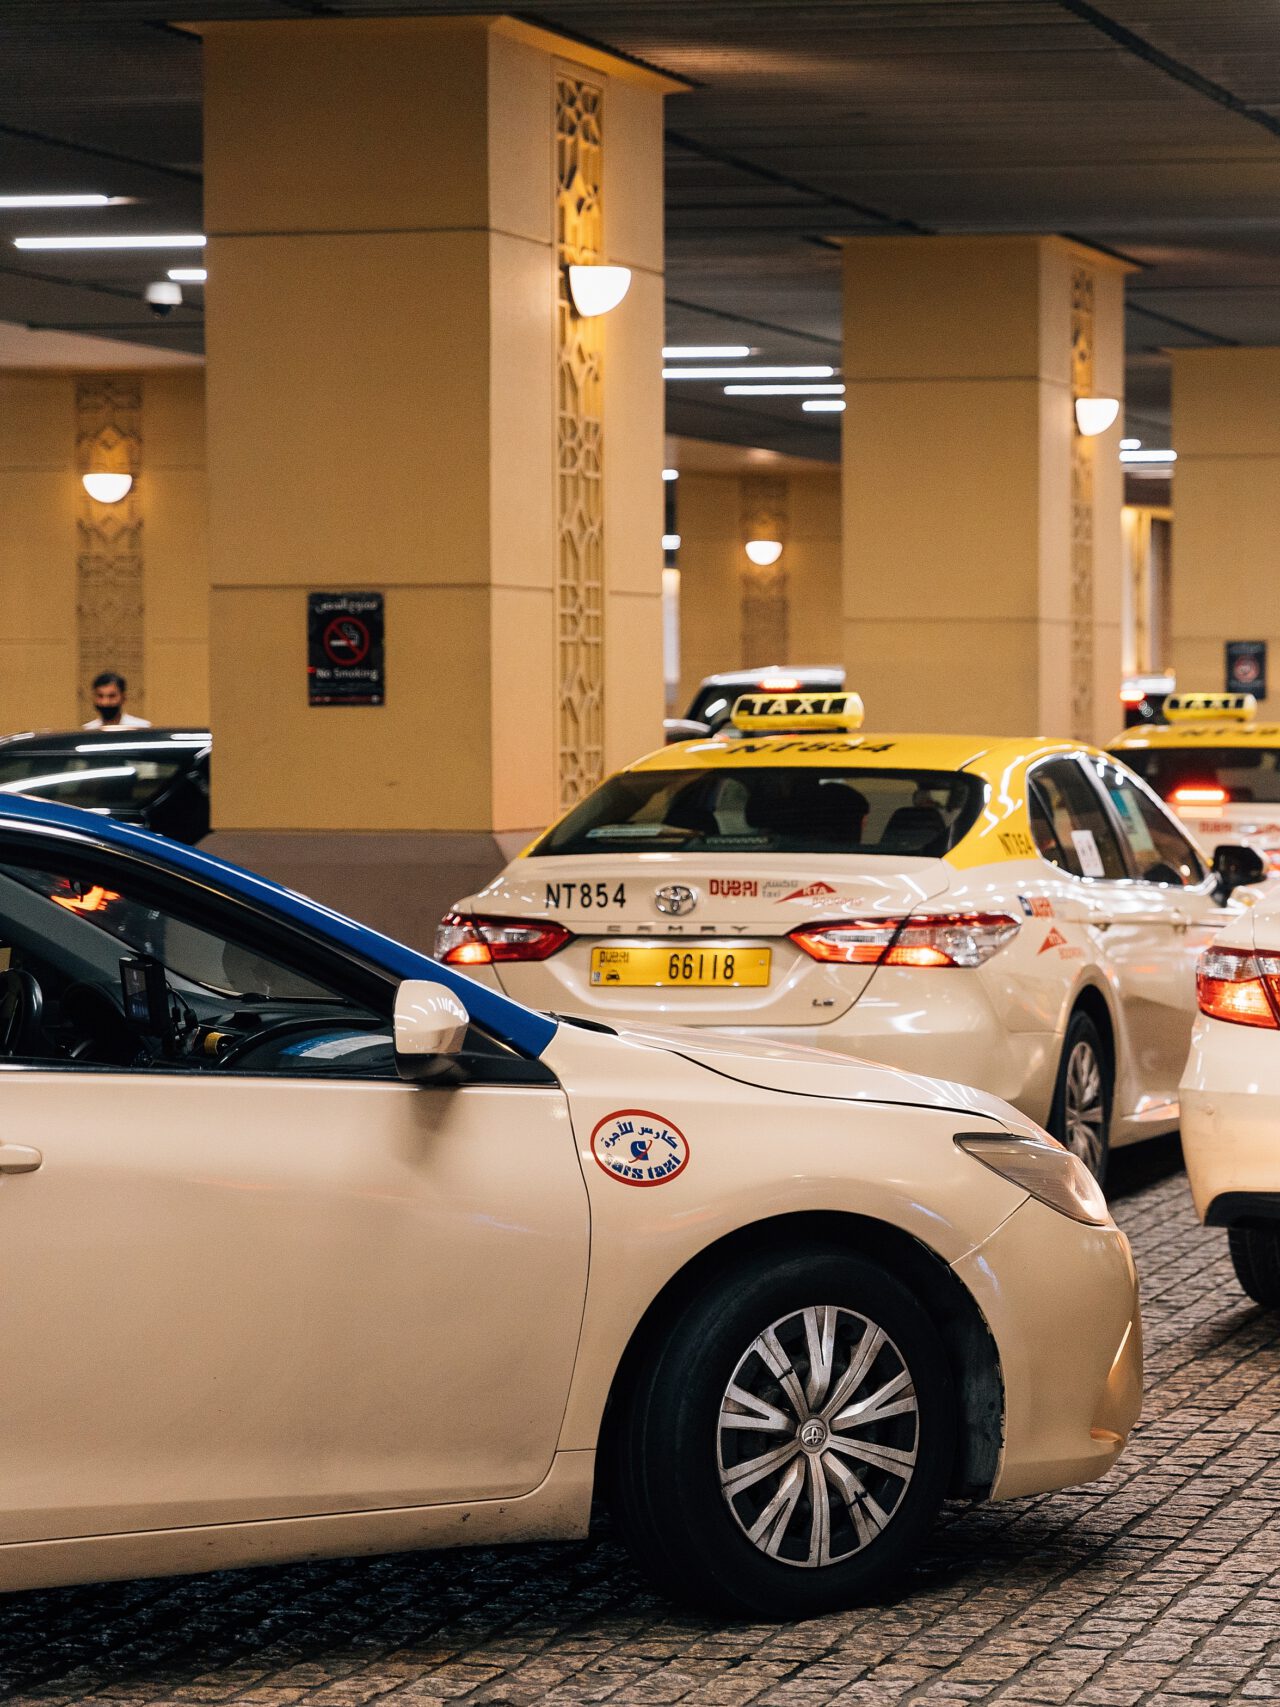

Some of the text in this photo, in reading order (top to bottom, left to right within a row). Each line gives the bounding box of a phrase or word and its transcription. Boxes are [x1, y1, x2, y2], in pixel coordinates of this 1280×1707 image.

[316, 668, 379, 681] No Smoking
[752, 699, 834, 715] TAXI
[545, 882, 627, 909] NT854
[709, 879, 758, 898] DUBAI
[669, 954, 735, 980] 66118
[638, 1127, 678, 1149] كارس
[647, 1153, 681, 1179] taxi
